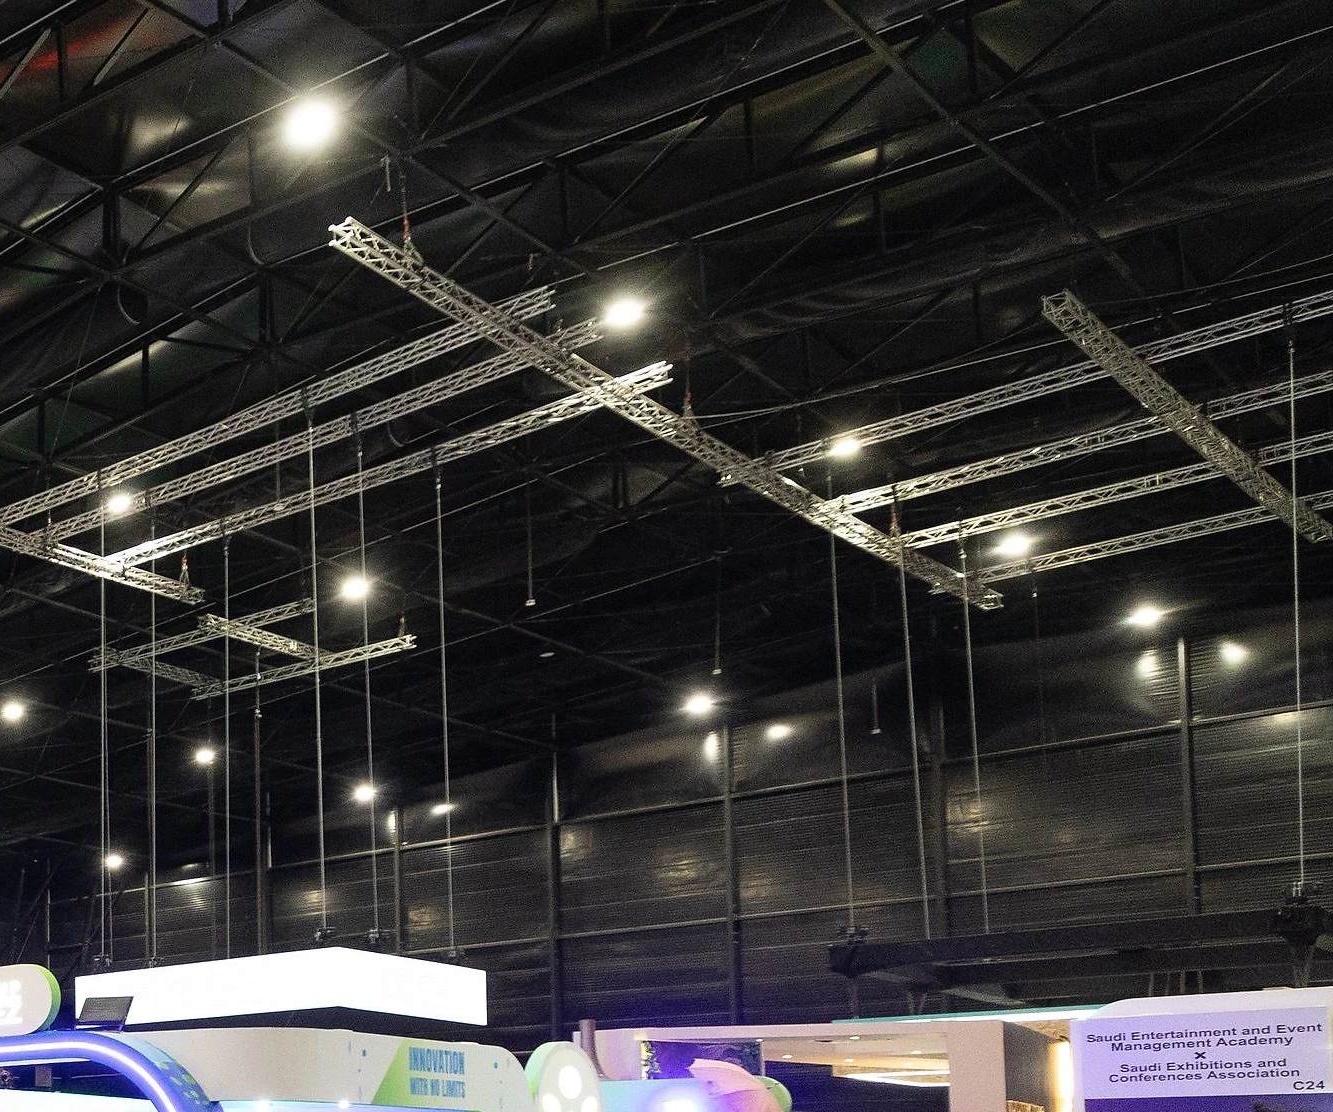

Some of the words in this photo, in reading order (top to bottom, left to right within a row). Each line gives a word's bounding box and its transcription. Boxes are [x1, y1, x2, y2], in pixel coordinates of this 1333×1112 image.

[1087, 1032, 1126, 1043] Saudi
[1131, 1027, 1237, 1041] Entertainment
[1241, 1025, 1271, 1036] and
[1276, 1023, 1323, 1034] Event
[1111, 1039, 1213, 1052] Management
[1216, 1035, 1294, 1048] Academy
[409, 1046, 465, 1075] INNOVATION
[1120, 1063, 1162, 1073] Saudi
[1166, 1060, 1253, 1072] Exhibitions
[1257, 1058, 1287, 1068] and
[1109, 1071, 1203, 1083] Conferences
[1206, 1068, 1300, 1080] Association
[410, 1077, 429, 1096] WITH
[441, 1079, 466, 1099] LIMITS
[1292, 1080, 1326, 1091] C24
